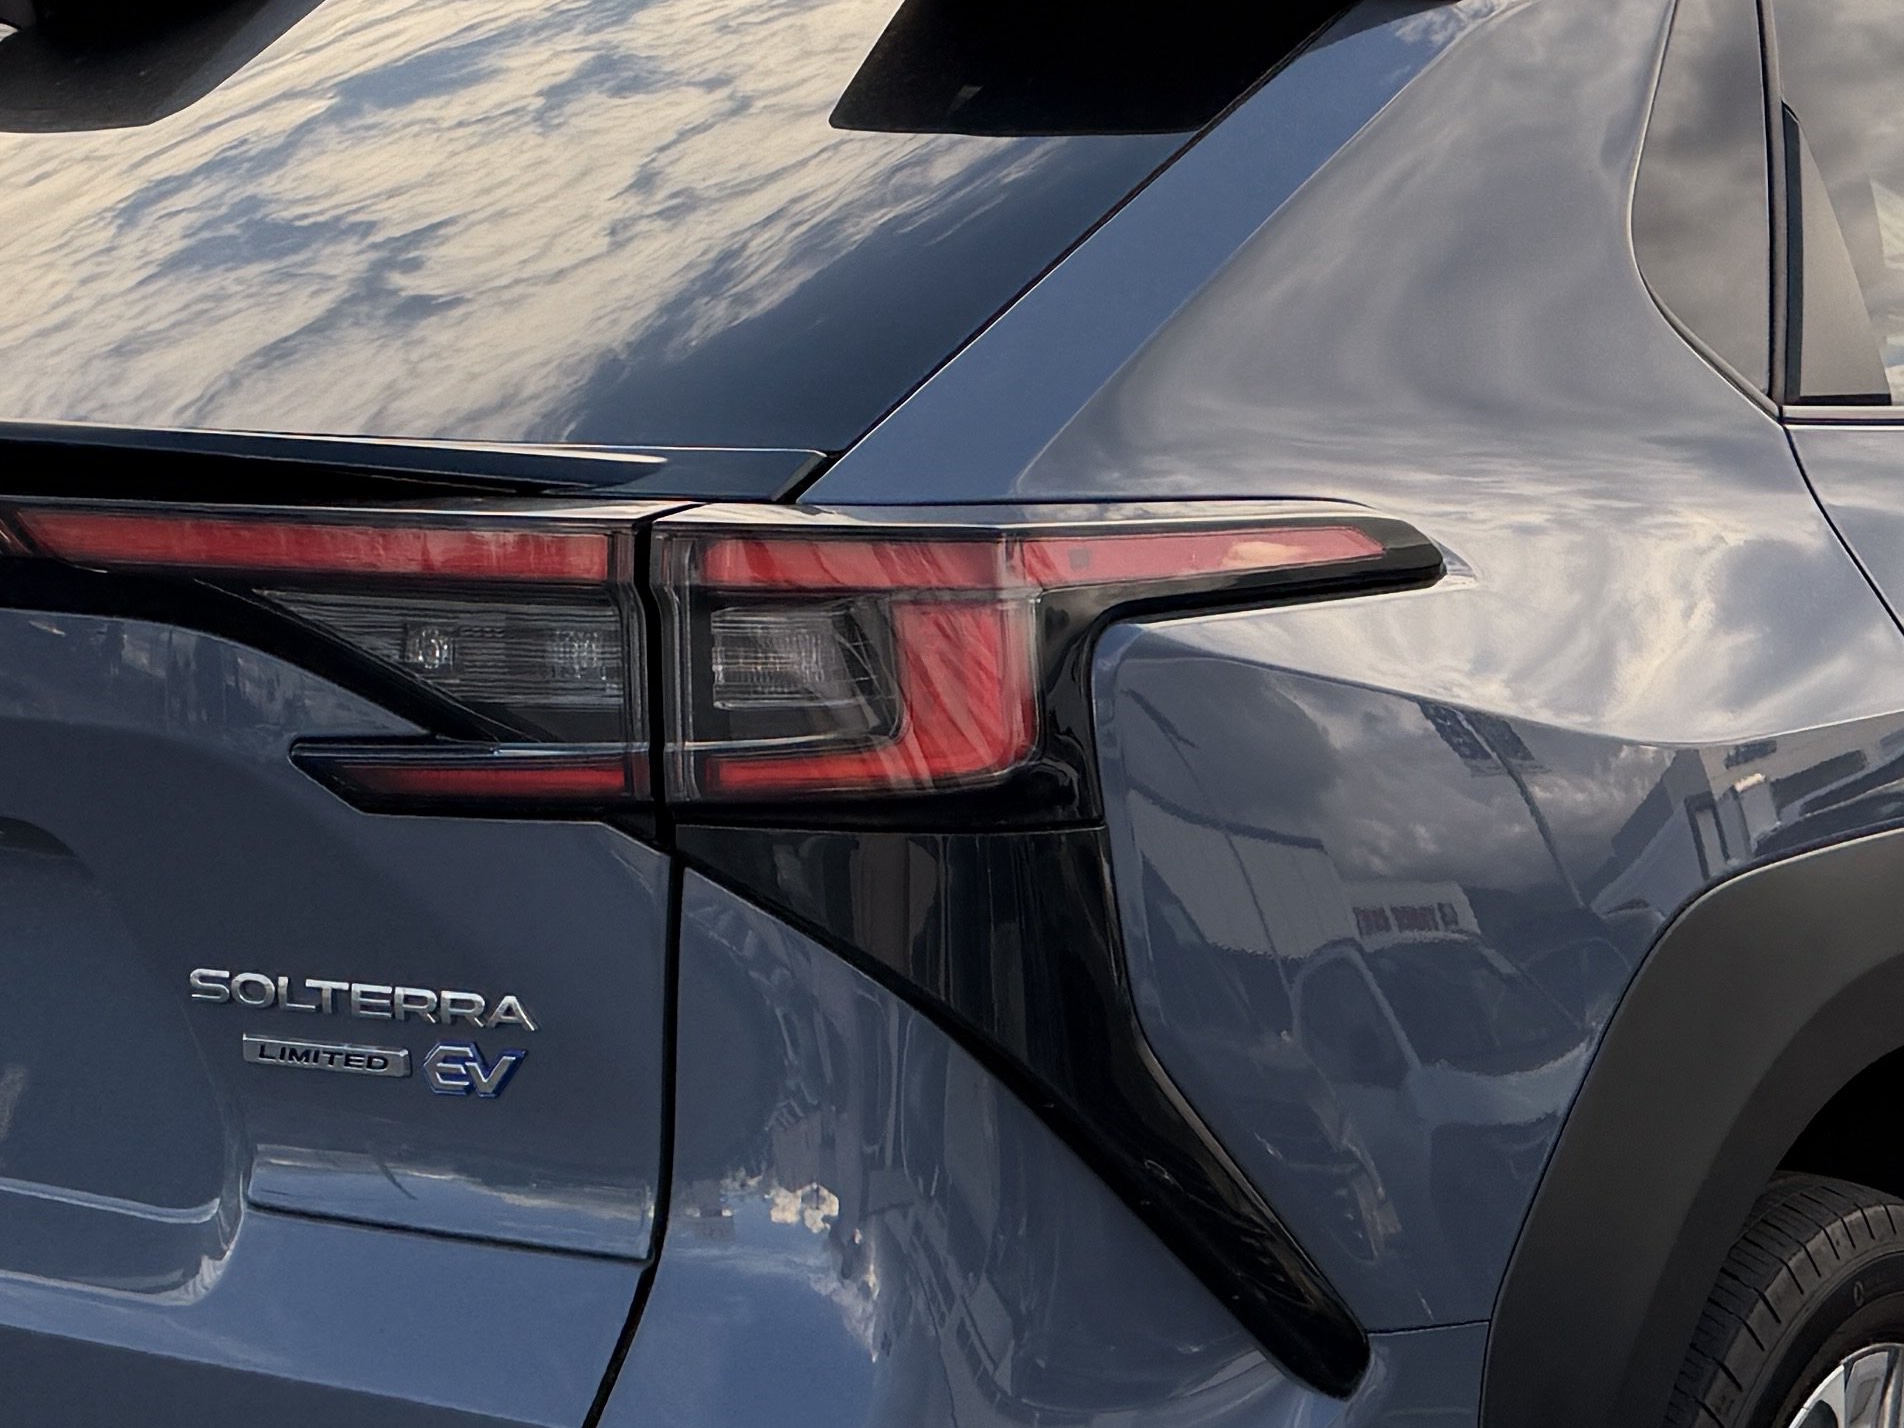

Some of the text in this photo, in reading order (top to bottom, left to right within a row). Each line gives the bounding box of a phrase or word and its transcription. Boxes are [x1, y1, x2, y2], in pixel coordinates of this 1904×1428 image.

[189, 967, 536, 1032] SOLTERRA
[258, 1039, 527, 1099] LIMITED EV
